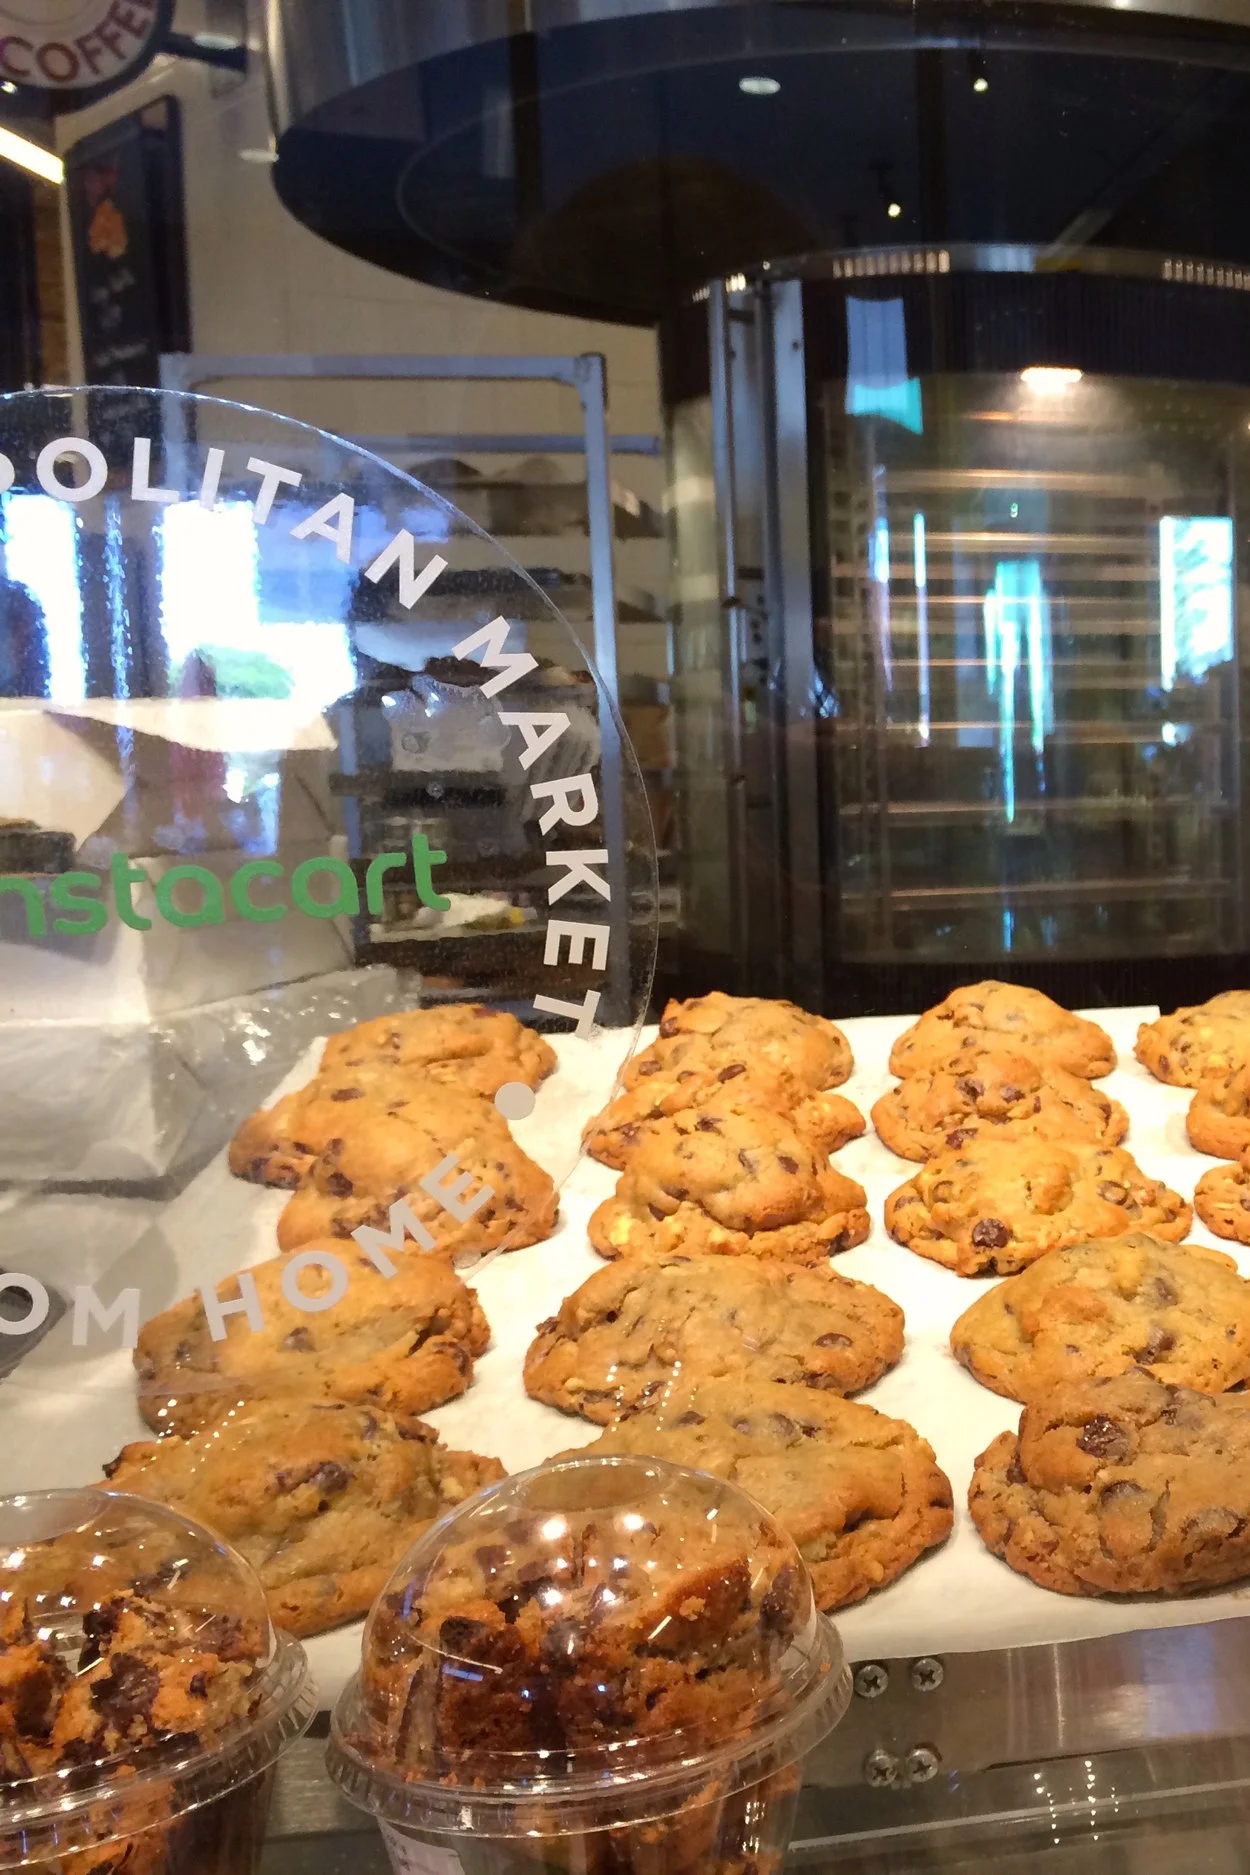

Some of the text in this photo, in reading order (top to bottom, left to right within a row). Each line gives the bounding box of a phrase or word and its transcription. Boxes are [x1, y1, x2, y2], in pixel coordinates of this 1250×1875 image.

[0, 0, 154, 83] COFFE
[0, 437, 612, 1038] OLITAN MARKET
[201, 1153, 495, 1341] HOME
